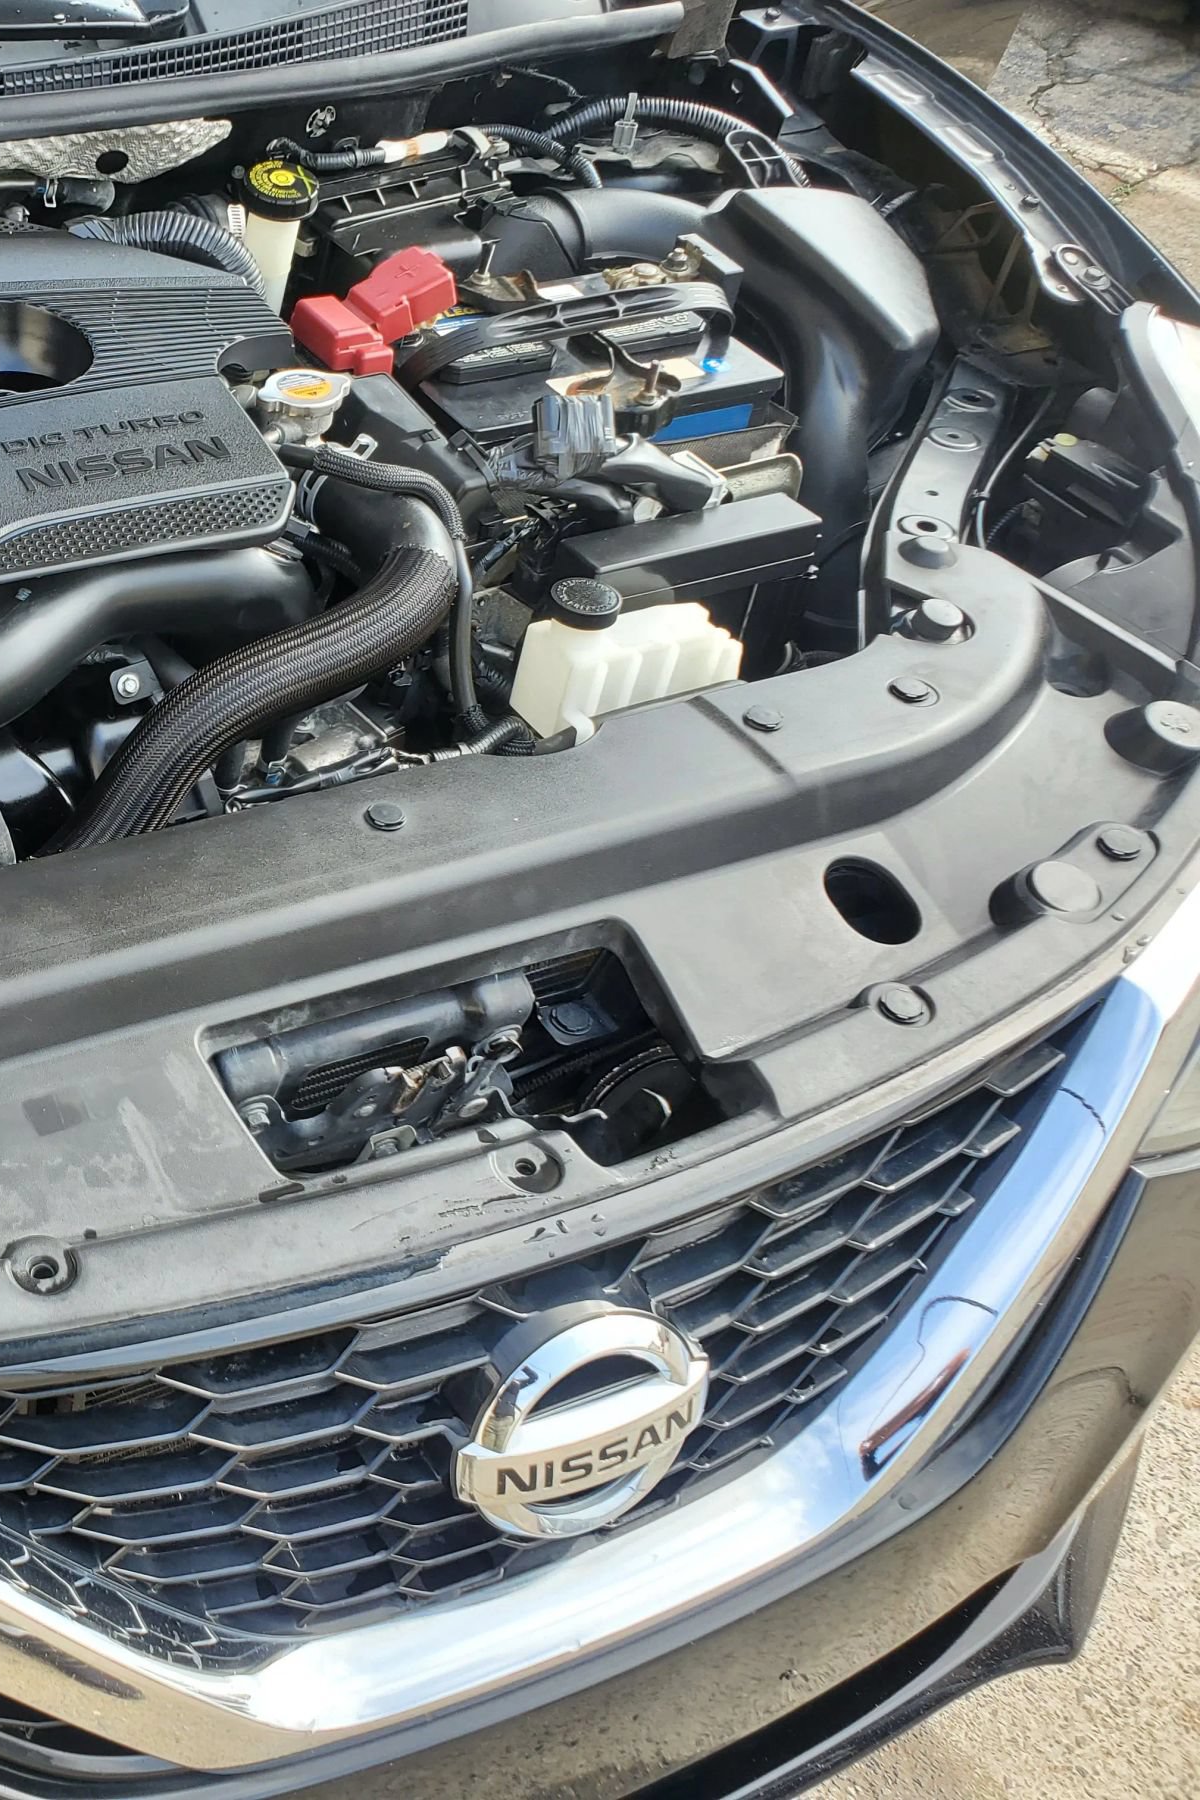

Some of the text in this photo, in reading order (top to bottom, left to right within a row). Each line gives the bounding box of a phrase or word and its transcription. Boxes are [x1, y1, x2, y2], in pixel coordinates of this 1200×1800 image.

[0, 410, 205, 454] DIG TURBO
[16, 435, 232, 492] NISSAN
[496, 1397, 694, 1496] NISSAN
